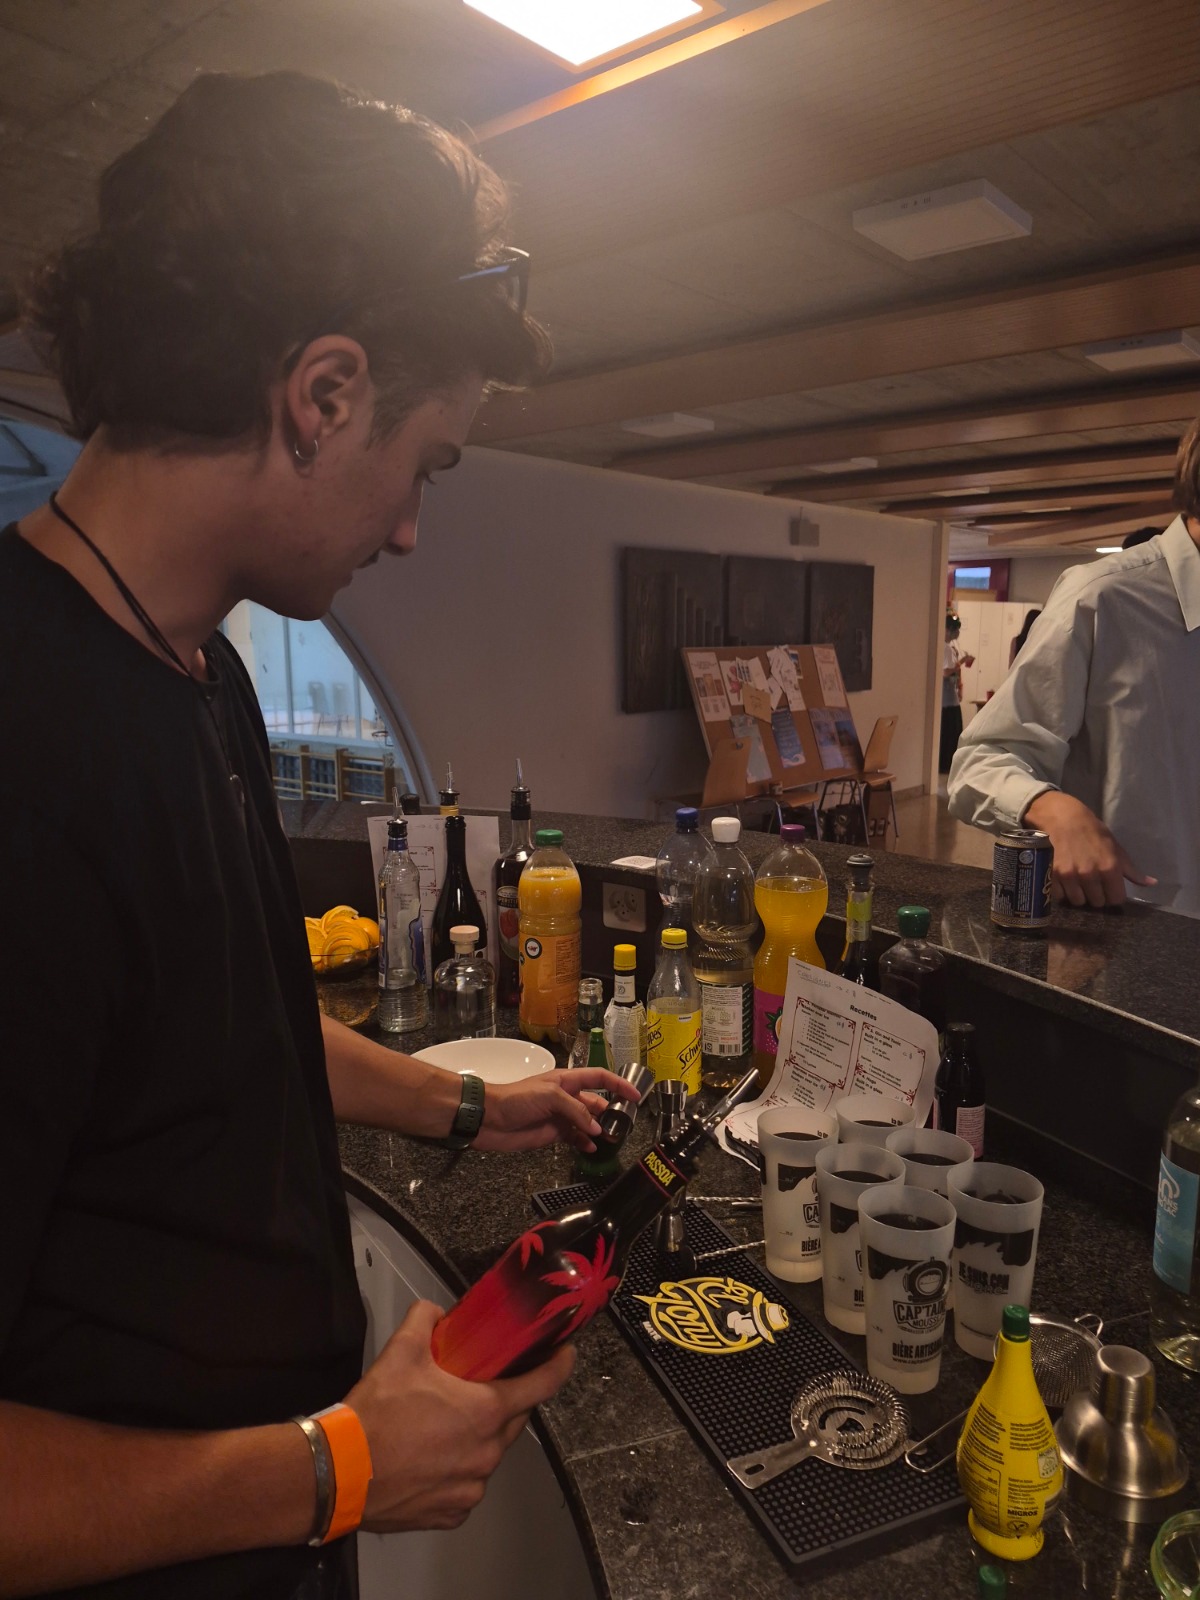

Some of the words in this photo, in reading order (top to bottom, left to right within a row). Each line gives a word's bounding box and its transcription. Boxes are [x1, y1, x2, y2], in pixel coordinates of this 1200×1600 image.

[850, 1004, 877, 1021] Recettes
[632, 1281, 748, 1347] Tony
[642, 1320, 662, 1342] MATE
[892, 1340, 914, 1358] BIÈRE
